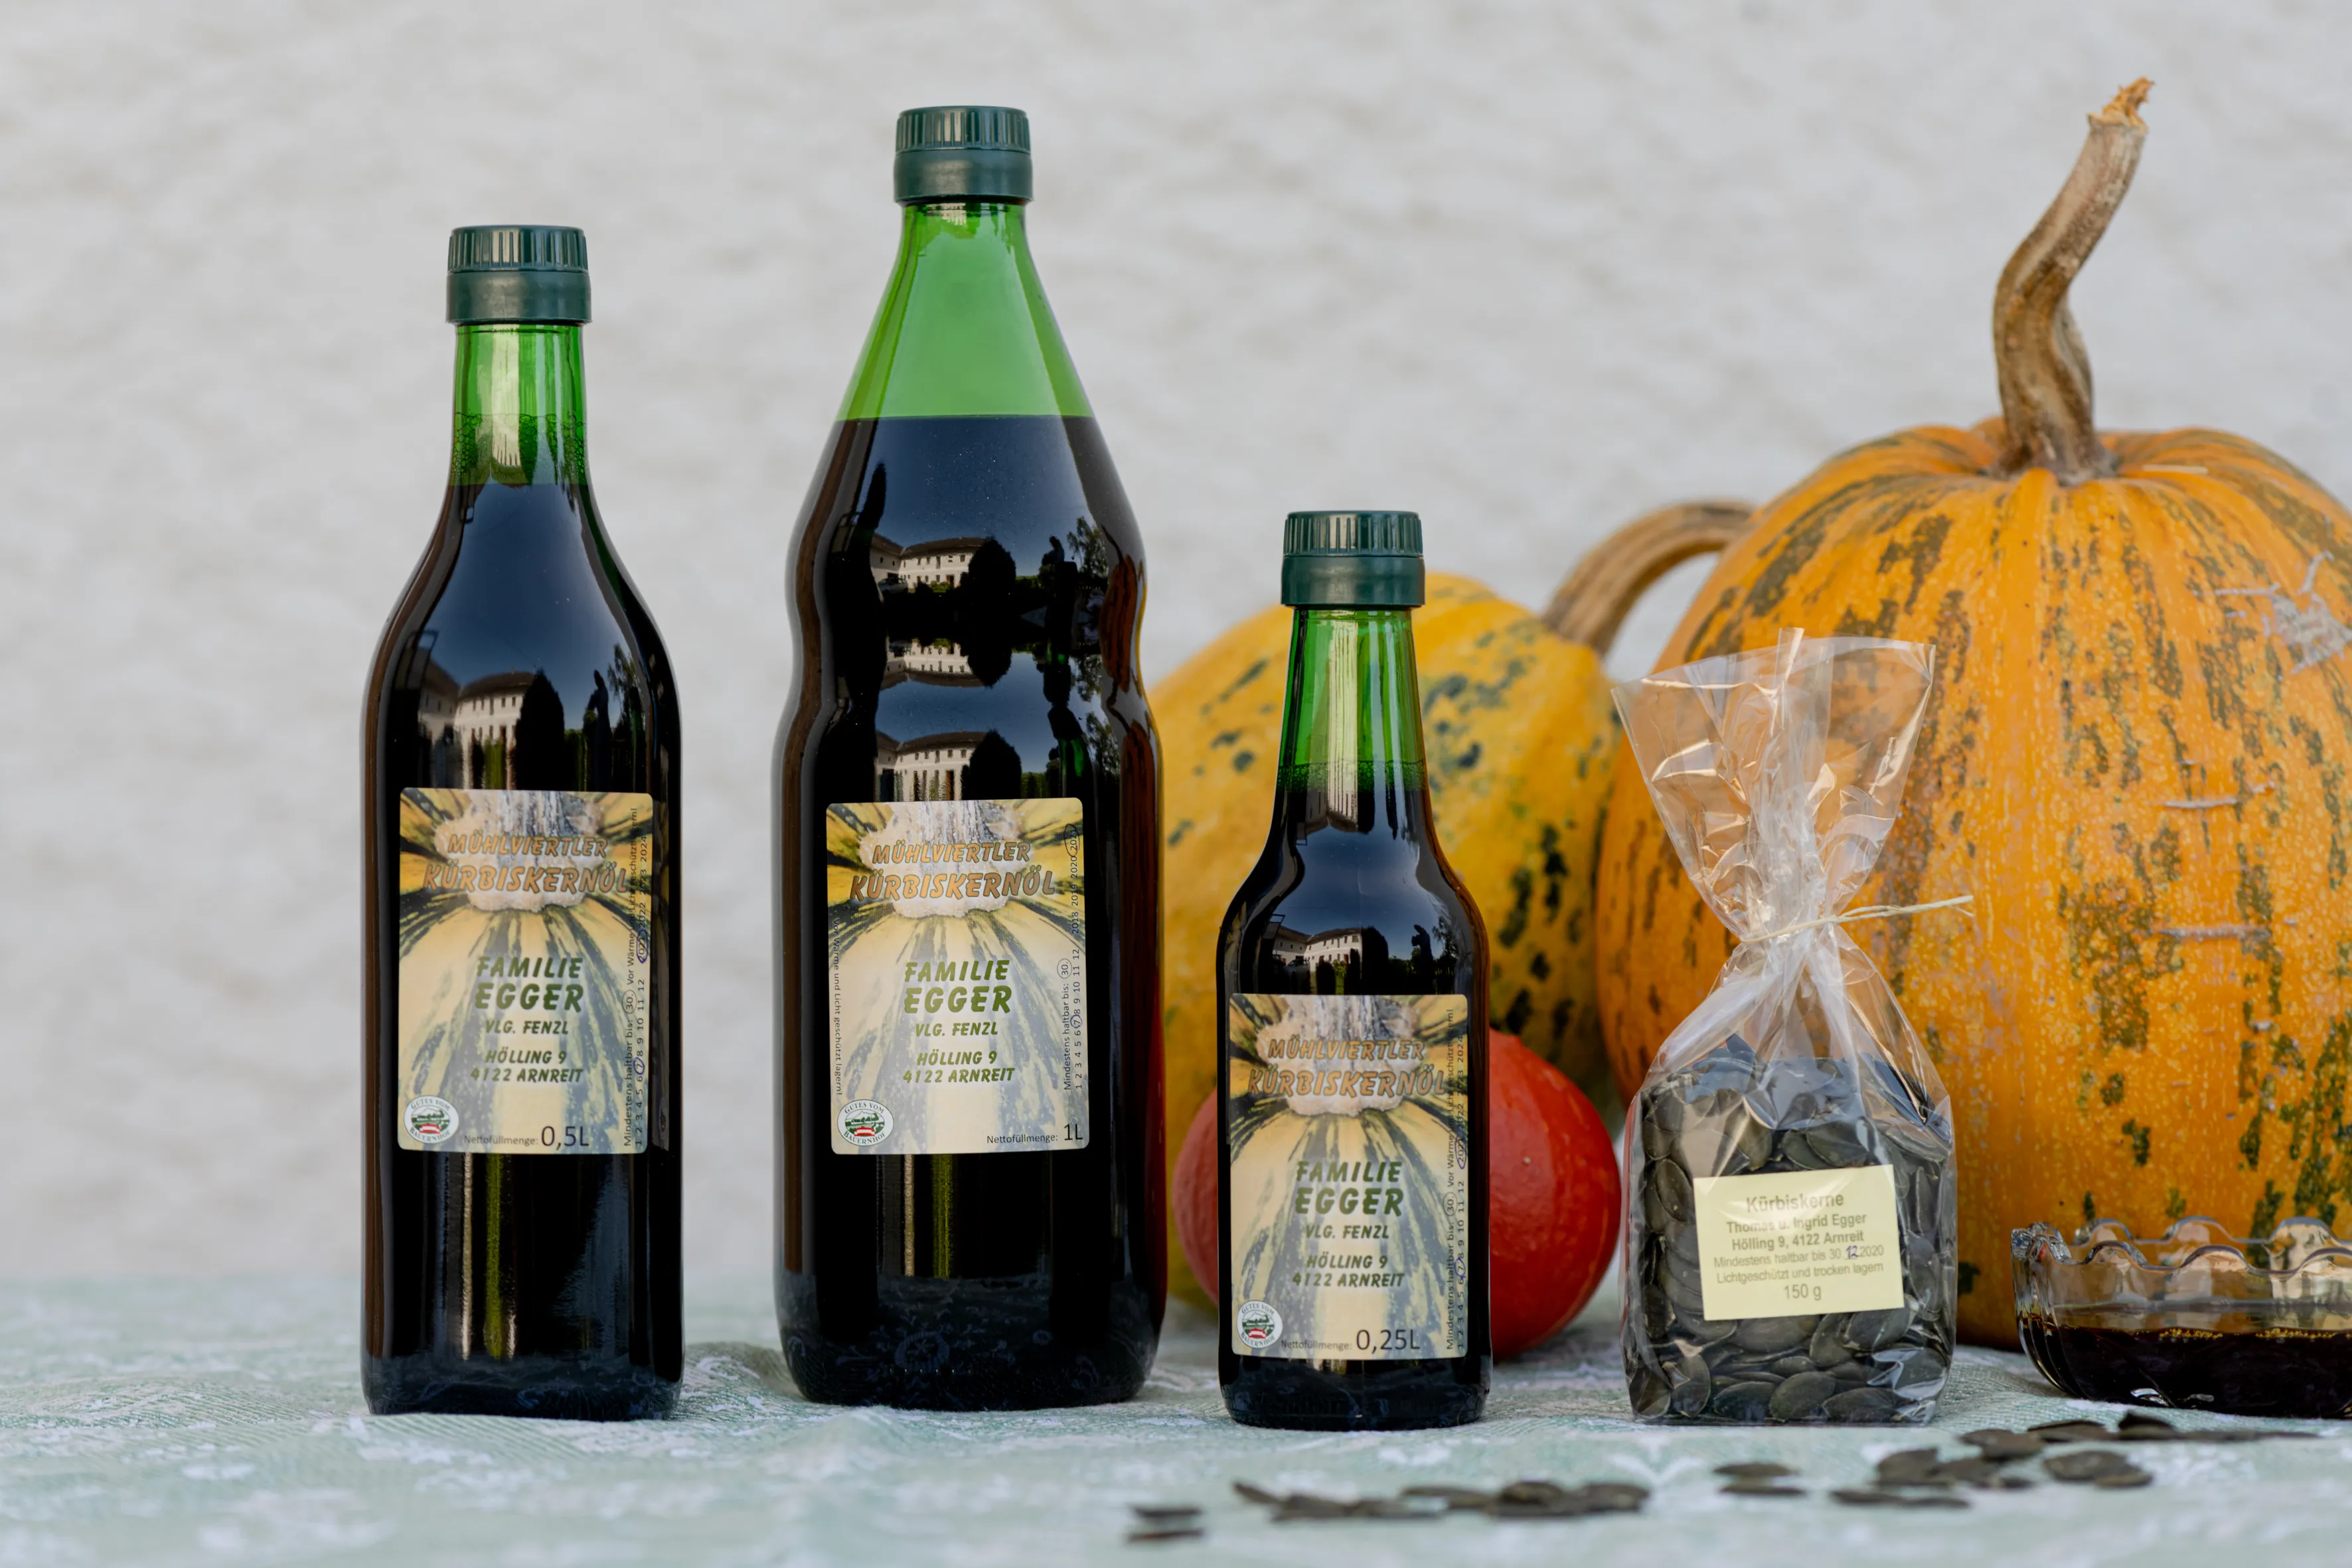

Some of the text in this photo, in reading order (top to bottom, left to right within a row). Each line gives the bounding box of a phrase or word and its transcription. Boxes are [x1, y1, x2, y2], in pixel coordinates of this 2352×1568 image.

[447, 829, 609, 857] MÜHLVIERTLER
[872, 839, 1030, 864] MÜHLVIERTLER
[422, 858, 628, 894] KÜRBISKERNÖL
[850, 864, 1056, 901] KÜRBISKERNÖL
[1073, 949, 1079, 959] 12
[477, 957, 583, 978] FAMILIE
[904, 960, 1010, 982] FAMILIE
[1073, 965, 1080, 975] 11
[638, 979, 645, 991] 12
[1073, 982, 1080, 992] 10
[475, 982, 584, 1012] EGGER
[637, 1000, 644, 1010] 11
[904, 985, 1012, 1014] EGGER
[485, 1020, 569, 1034] VLG. FENZL
[637, 1018, 644, 1030] 10
[915, 1022, 998, 1037] VLG. FENZL
[485, 1047, 567, 1064] HÖLLING 9
[1268, 1034, 1425, 1061] MÜHLVIERTLER
[917, 1049, 997, 1065] HÖLLING 9
[470, 1067, 584, 1083] 4122 ARNREIT
[903, 1067, 1015, 1083] 4122 ARNREIT
[1247, 1063, 1445, 1097] KÜRBISKERNÖL
[624, 1083, 633, 1146] Mindestens
[844, 1102, 884, 1113] GUTES VOM
[465, 1126, 589, 1150] Nettofüllmenge: 0,5L
[844, 1131, 885, 1144] BAUERNHOF
[986, 1134, 1058, 1143] Nettofüllmenge:
[1296, 1161, 1402, 1182] FAMILIE
[1295, 1187, 1403, 1217] EGGER
[1746, 1193, 1844, 1213] Kürbiskerne
[1794, 1215, 1828, 1230] Ingrid
[1832, 1214, 1867, 1228] Egger
[1306, 1225, 1389, 1239] VLG. FENZL
[1731, 1230, 1865, 1251] Hölling 9, 4122 Arnreit
[1306, 1251, 1387, 1269] HÖLLING 9
[1714, 1254, 1772, 1268] Mindestens
[1774, 1251, 1809, 1265] haltbar
[1812, 1249, 1826, 1261] bis
[1292, 1273, 1405, 1288] 4122 ARNREIT
[1717, 1262, 1883, 1285] Lichtgeschützt und trocken lagern
[1784, 1284, 1822, 1300] 150 g
[1356, 1329, 1419, 1354] 0,25L
